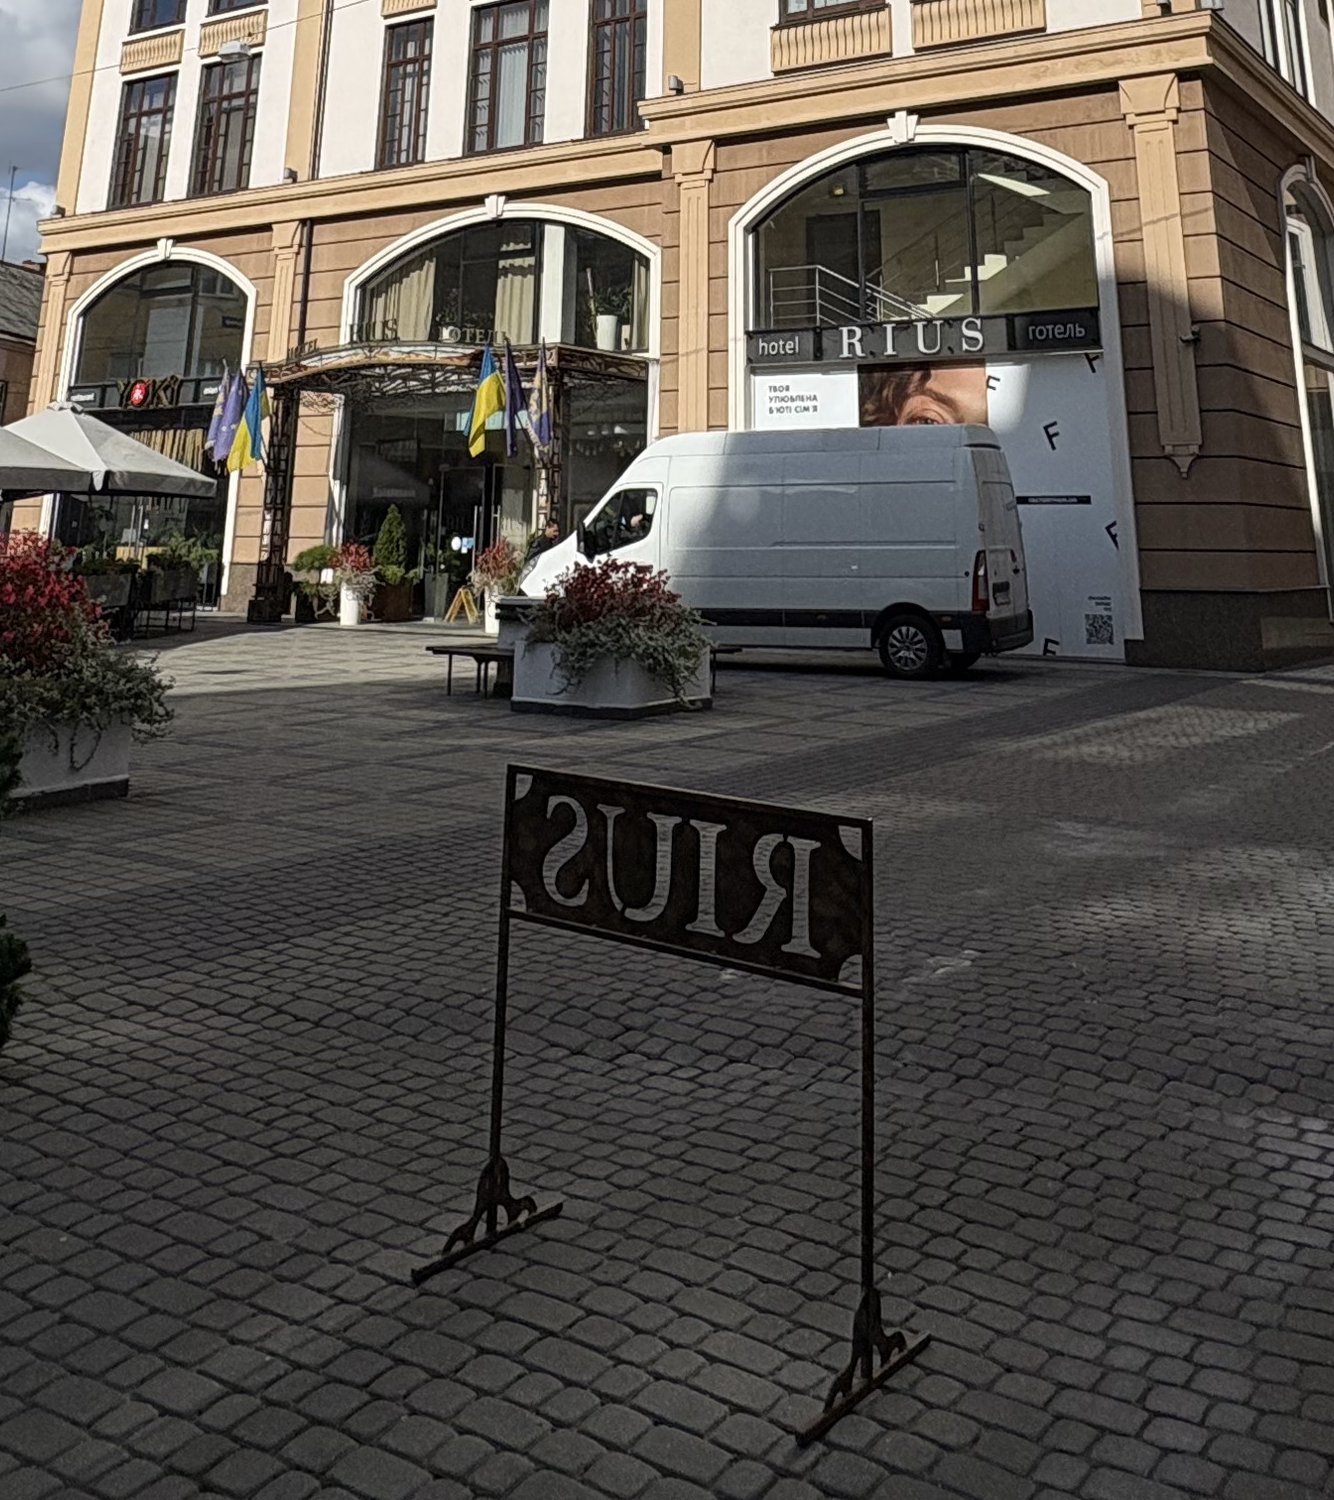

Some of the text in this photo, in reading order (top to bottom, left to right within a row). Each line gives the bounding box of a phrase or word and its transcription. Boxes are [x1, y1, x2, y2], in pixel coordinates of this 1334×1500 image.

[759, 317, 1086, 359] hotel RIUS готель
[768, 385, 790, 393] ТВОЯ
[1043, 420, 1060, 451] F
